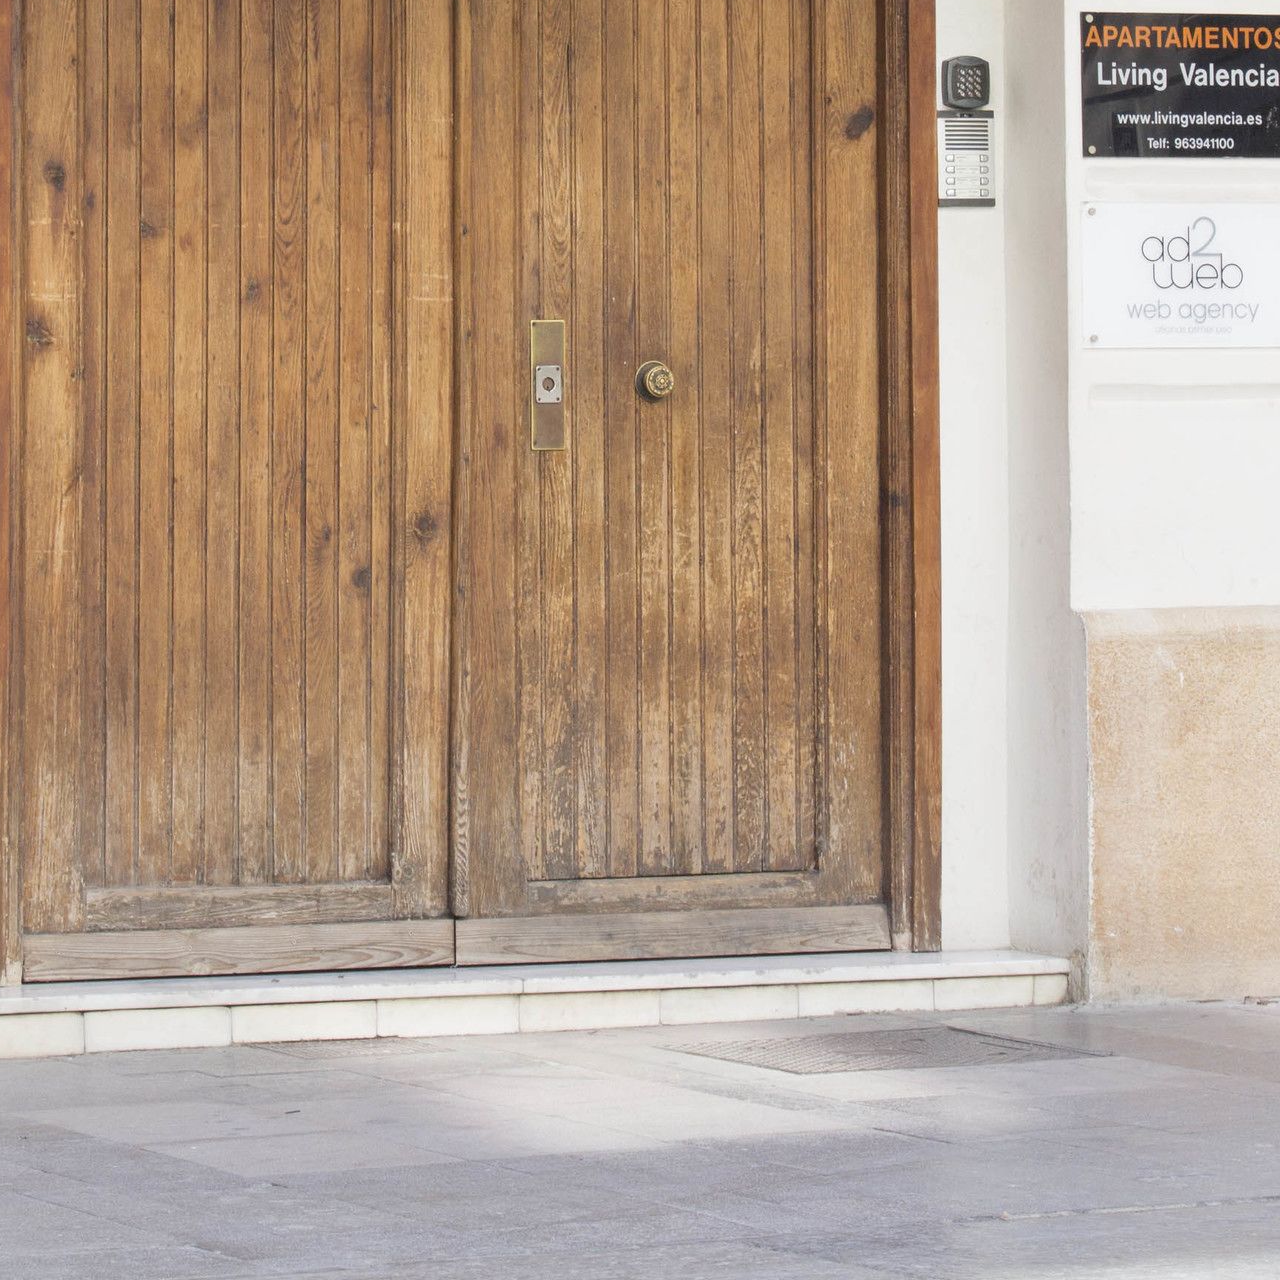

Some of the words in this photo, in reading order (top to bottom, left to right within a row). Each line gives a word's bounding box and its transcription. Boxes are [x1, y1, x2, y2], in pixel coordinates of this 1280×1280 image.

[1097, 62, 1167, 91] Living
[1180, 63, 1280, 87] Valencia
[1117, 111, 1263, 127] www.livingvalencia.es
[1147, 137, 1170, 149] Telf:
[1174, 138, 1235, 150] 963941100
[1153, 253, 1244, 289] web
[1127, 300, 1171, 319] web
[1179, 302, 1259, 323] agency
